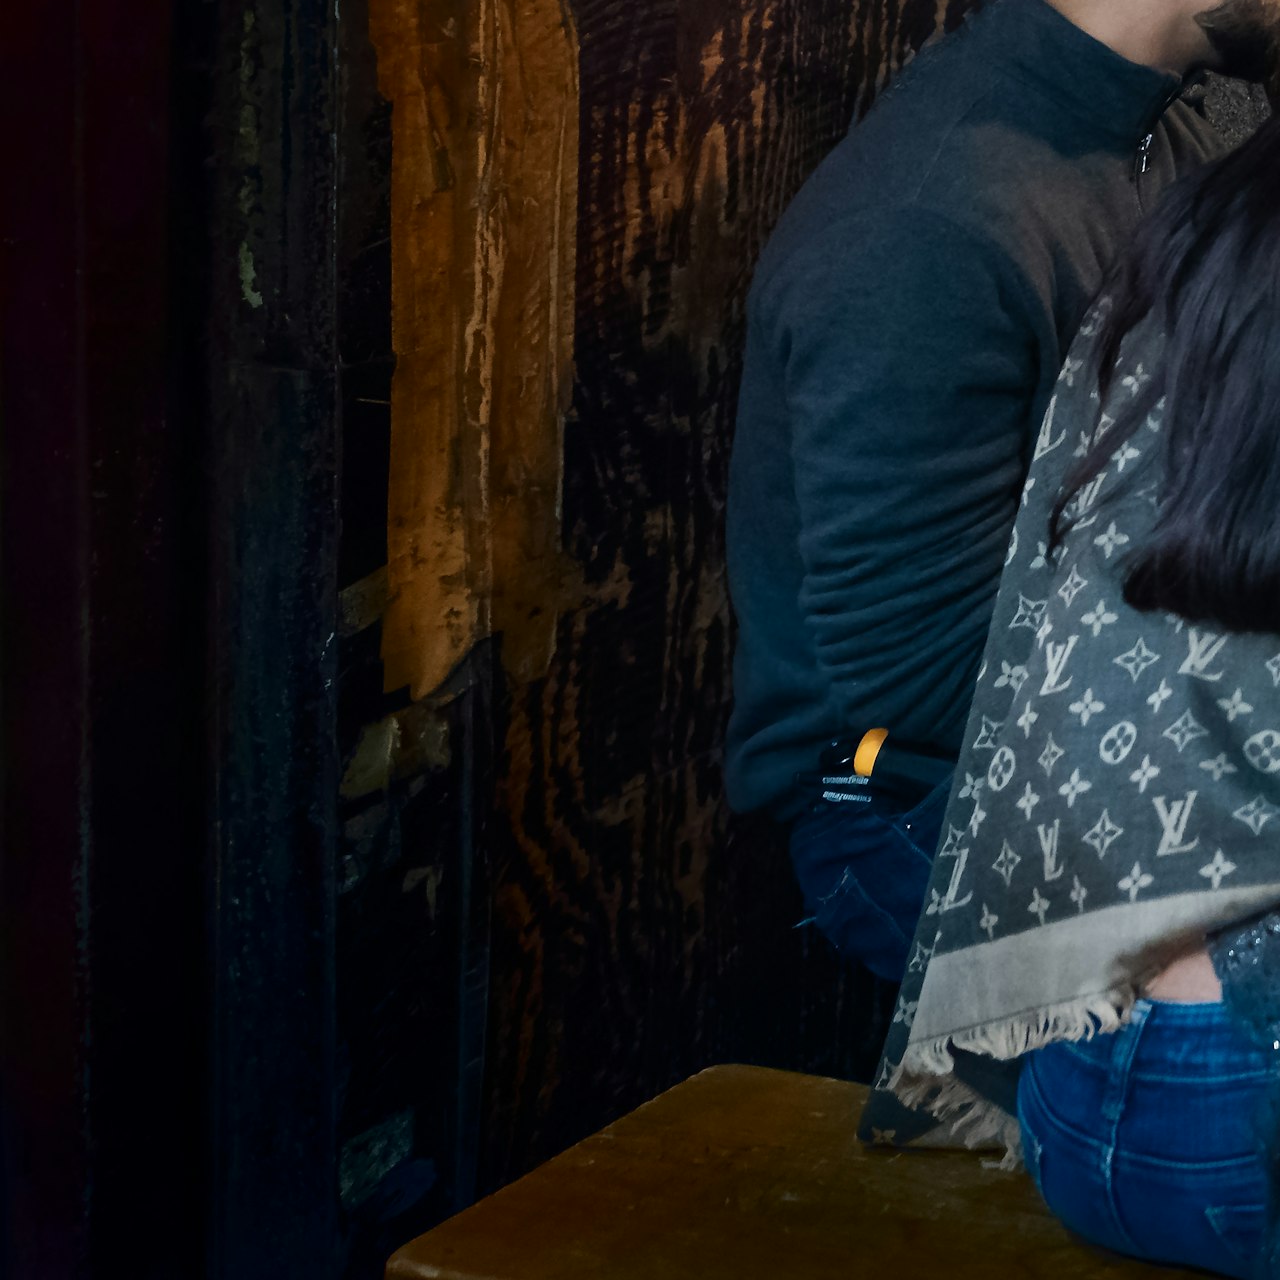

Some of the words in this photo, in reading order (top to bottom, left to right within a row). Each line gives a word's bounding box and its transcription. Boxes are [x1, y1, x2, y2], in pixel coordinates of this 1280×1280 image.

[1039, 635, 1079, 697] LV
[1038, 819, 1064, 881] LV
[1153, 790, 1199, 857] LV
